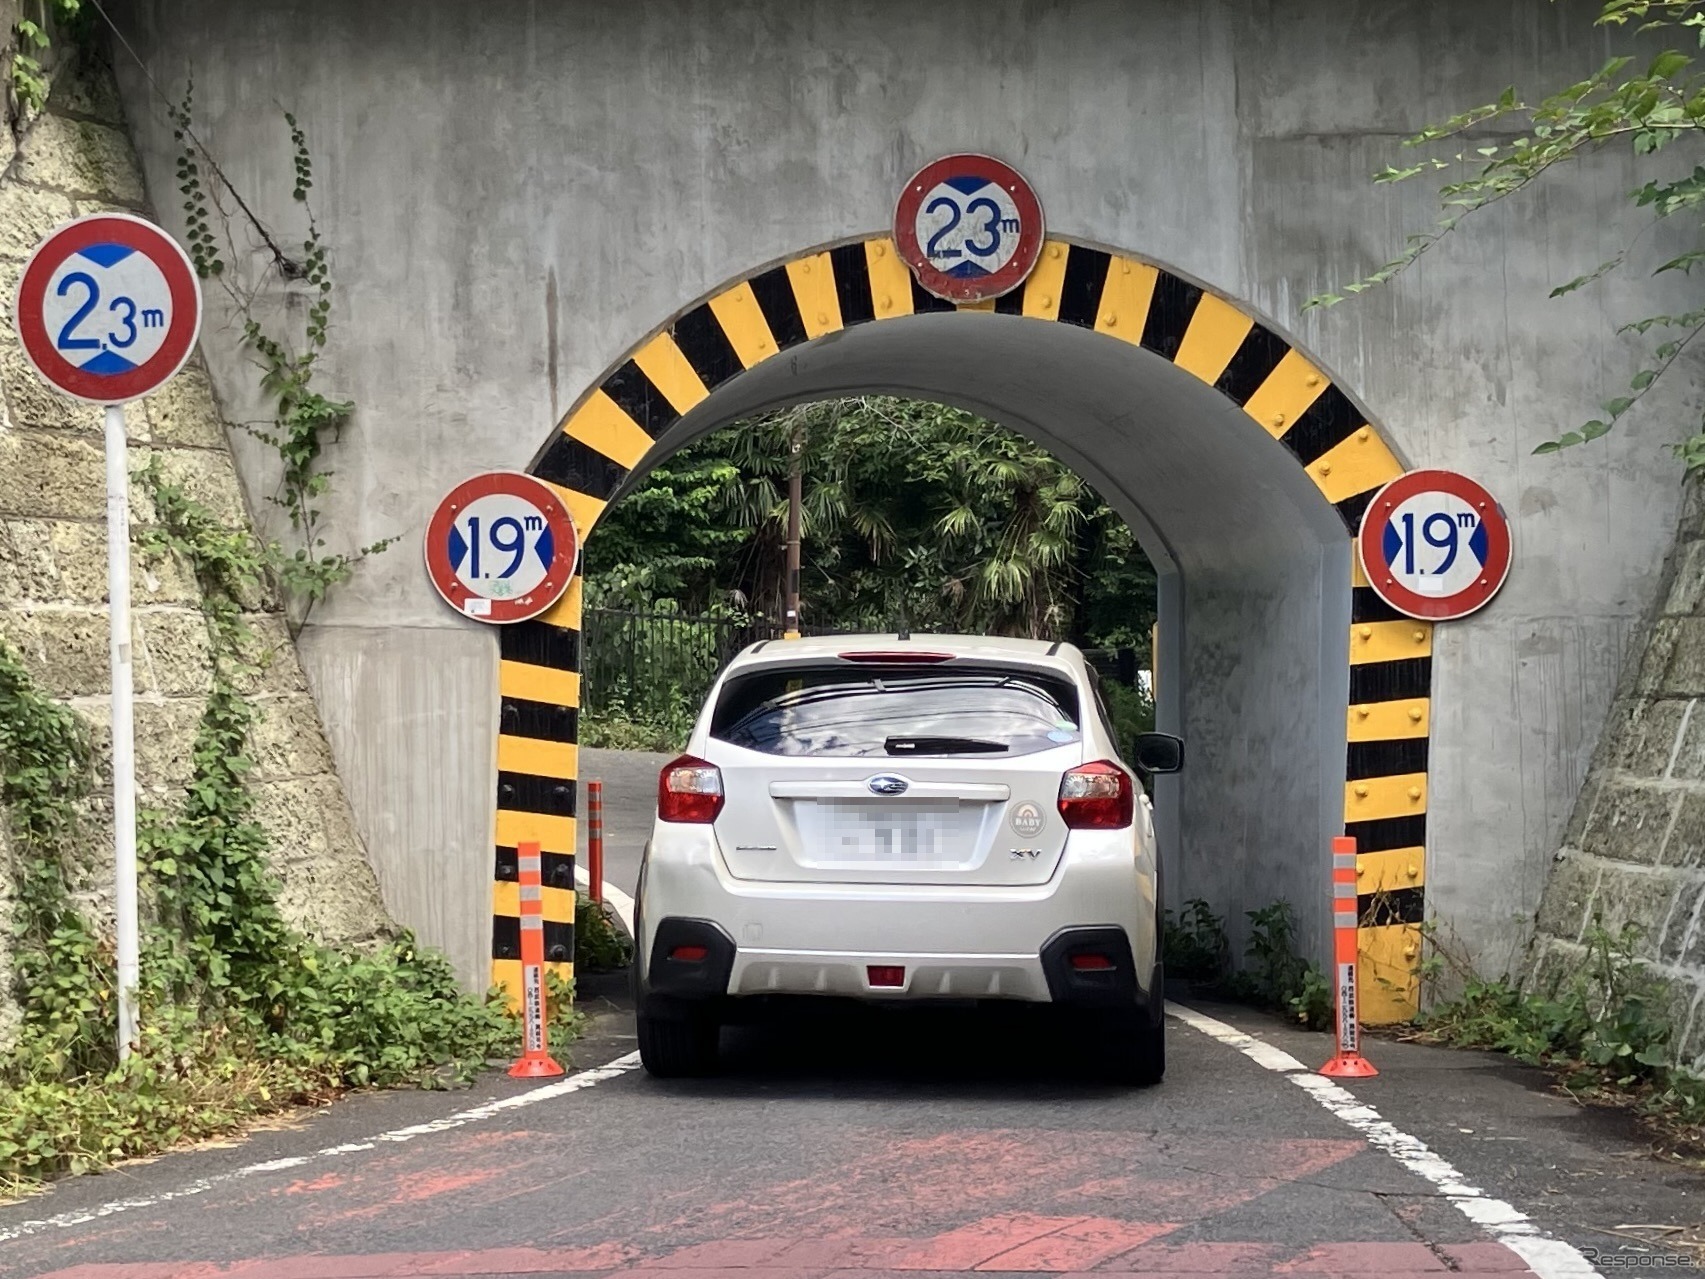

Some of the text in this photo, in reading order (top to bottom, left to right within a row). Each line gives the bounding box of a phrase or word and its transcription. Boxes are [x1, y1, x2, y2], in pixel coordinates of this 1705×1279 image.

[57, 271, 165, 350] 2.3m
[467, 516, 543, 579] 1.9m
[1401, 512, 1476, 575] 1.9m
[1010, 848, 1042, 861] XV
